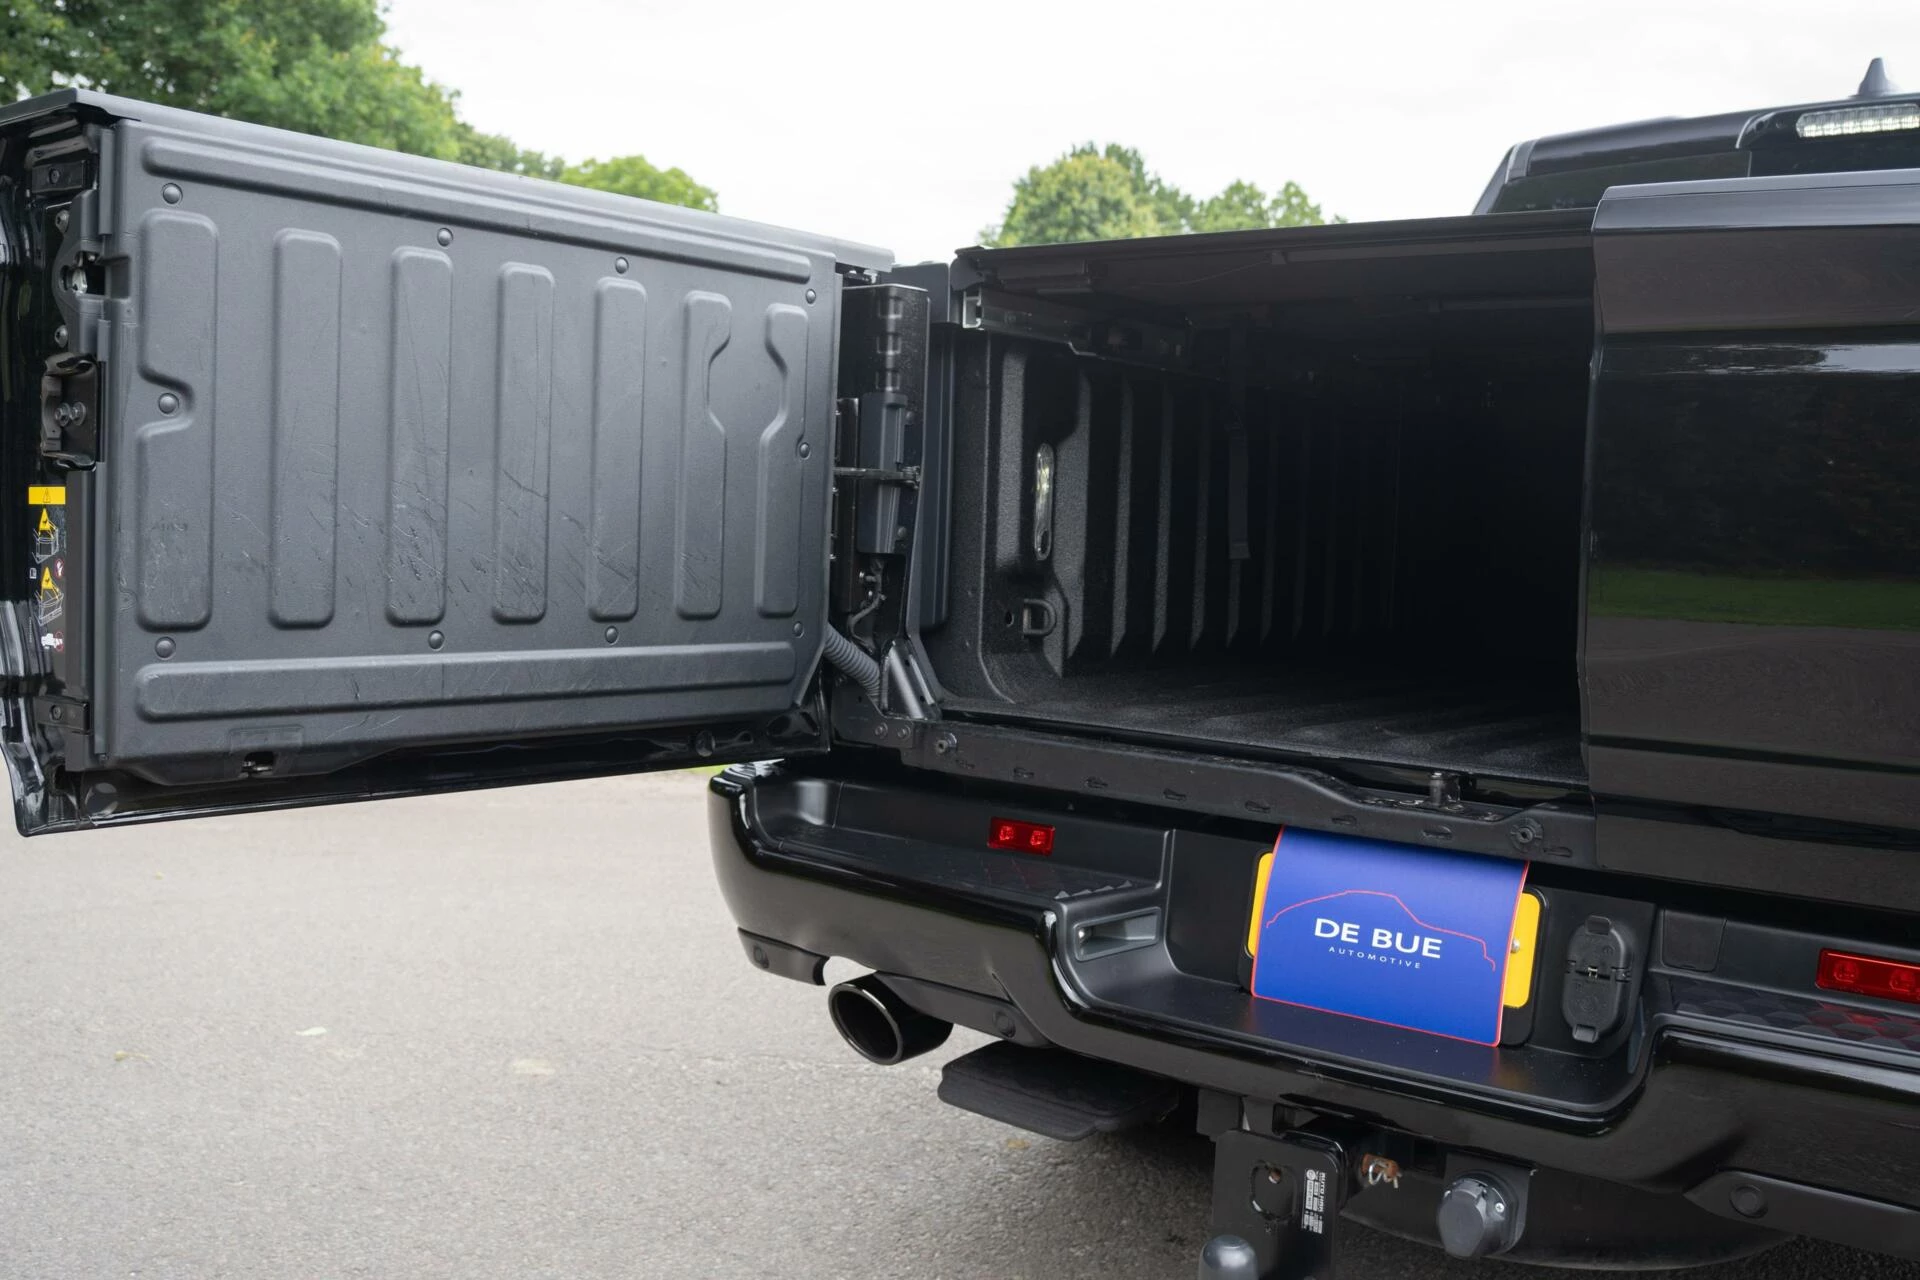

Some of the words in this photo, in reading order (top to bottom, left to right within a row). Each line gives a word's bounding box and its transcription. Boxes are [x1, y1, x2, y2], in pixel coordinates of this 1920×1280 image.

[1315, 918, 1360, 943] DE
[1371, 928, 1442, 958] BUE
[1328, 946, 1420, 969] AUTOMOTIVE
